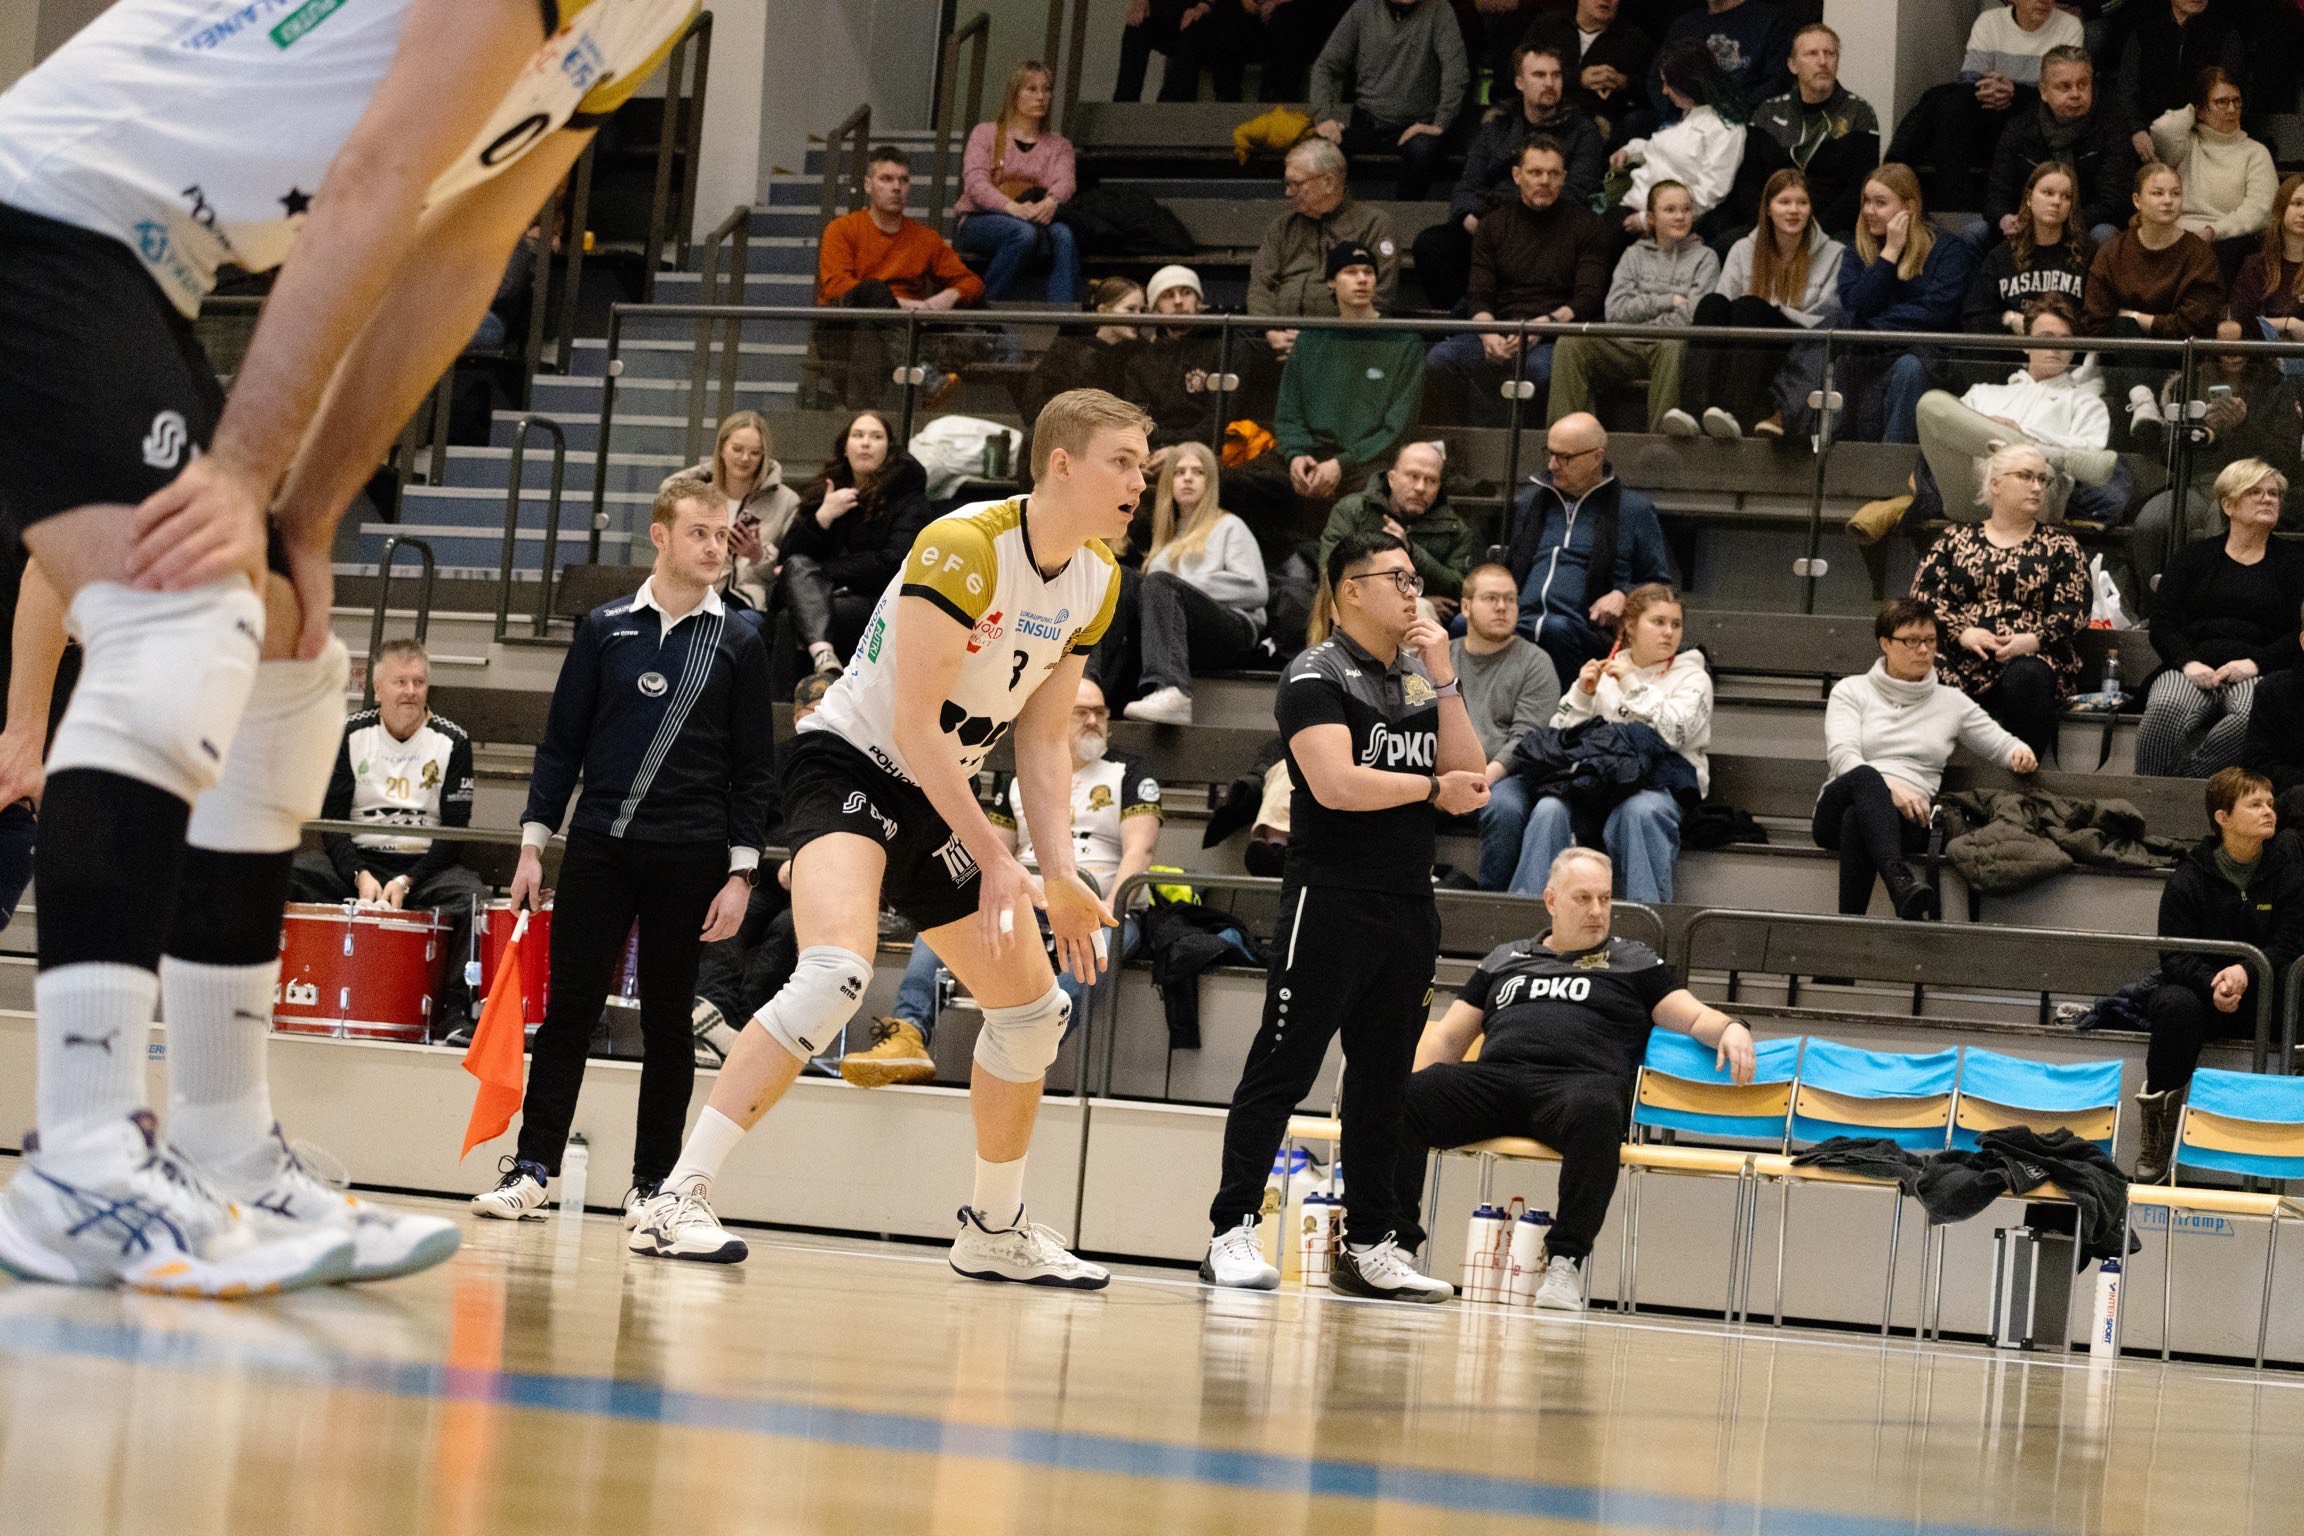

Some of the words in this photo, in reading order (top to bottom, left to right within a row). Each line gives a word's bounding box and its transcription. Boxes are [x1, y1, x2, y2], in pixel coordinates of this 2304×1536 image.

[1999, 270, 2082, 300] PASADENA
[1387, 731, 1437, 767] PKO
[385, 776, 410, 800] 20
[955, 866, 977, 884] Parasta
[1529, 976, 1591, 1002] PKO
[2104, 1291, 2116, 1344] INTERSPORT
